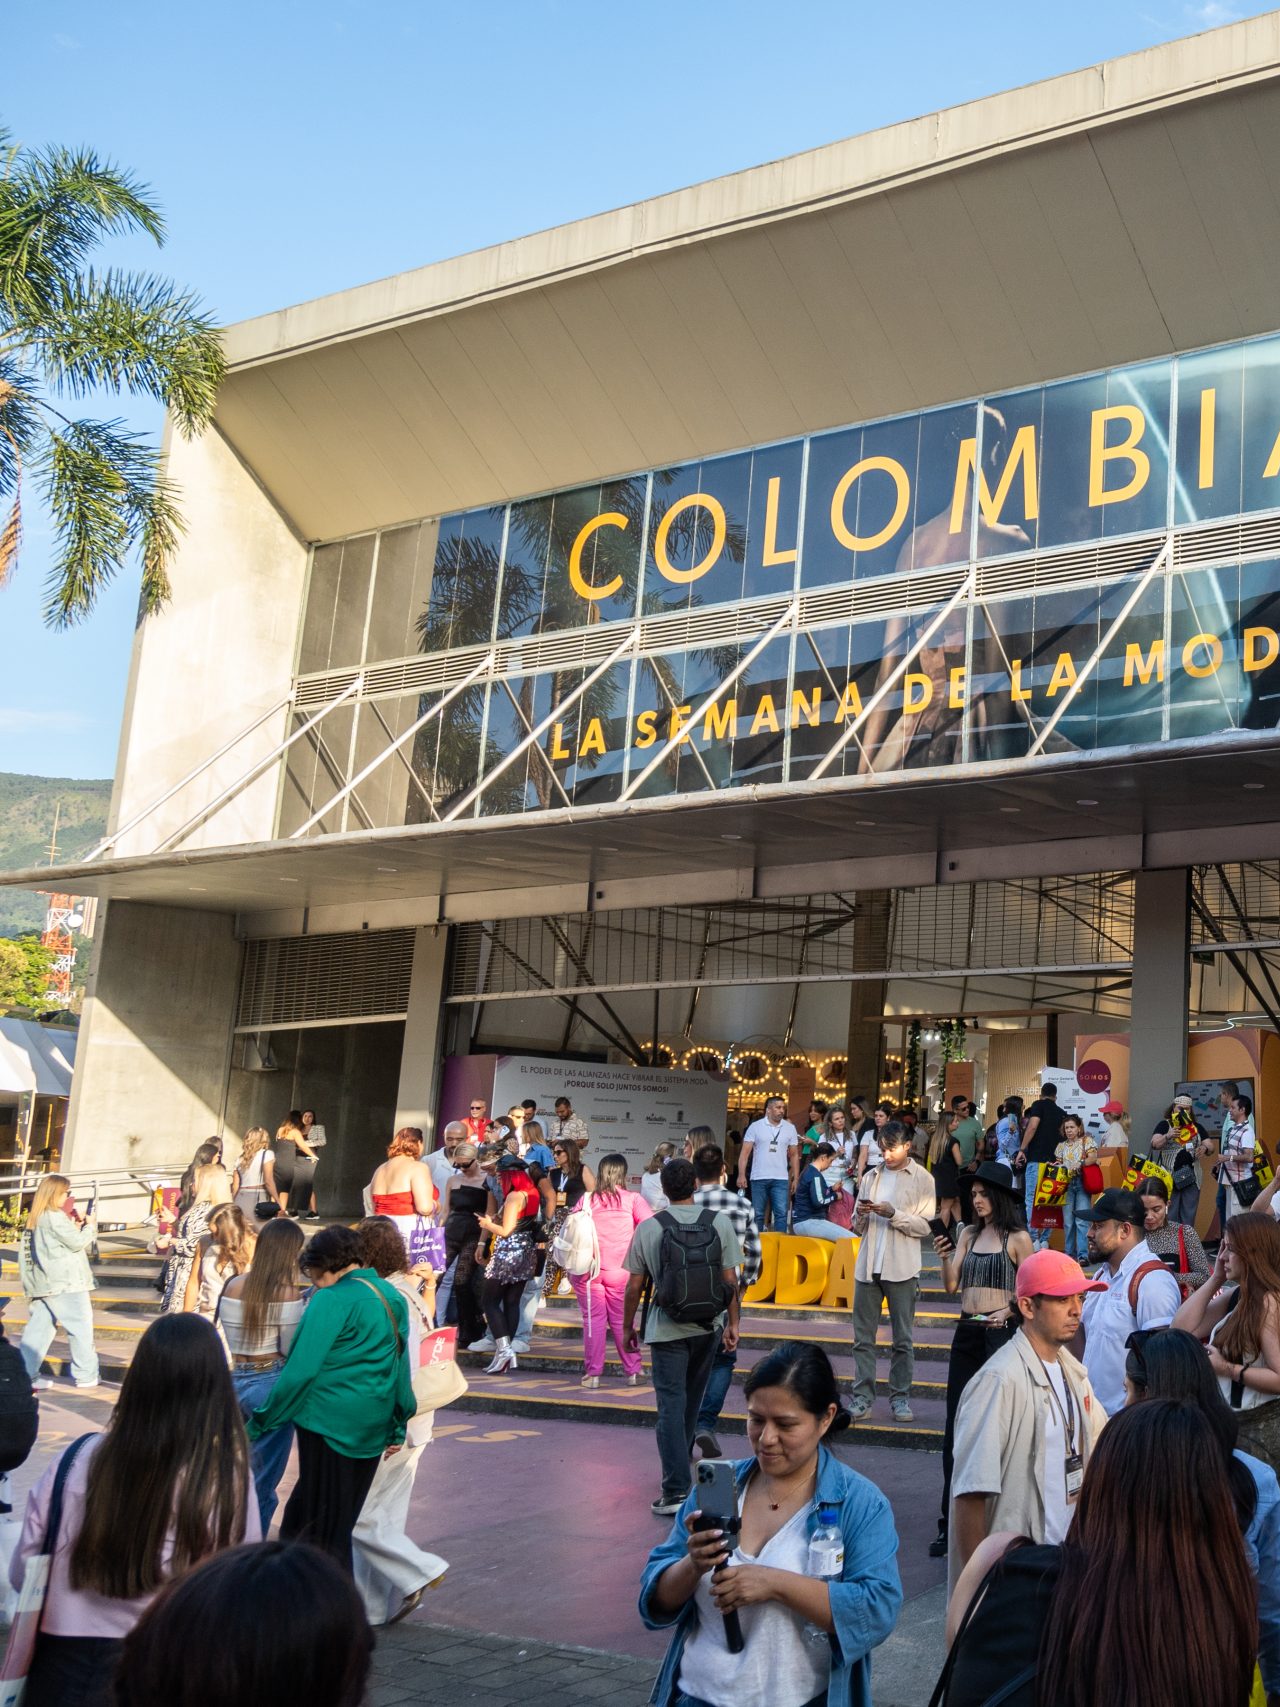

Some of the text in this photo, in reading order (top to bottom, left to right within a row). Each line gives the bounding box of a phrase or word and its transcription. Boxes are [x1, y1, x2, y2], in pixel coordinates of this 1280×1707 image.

[552, 717, 607, 760] LA
[634, 681, 865, 749] SEMANA
[902, 666, 968, 716] DE
[1011, 652, 1083, 701] LA
[520, 1066, 709, 1086] EL PODER DE LAS ALIANZAS HACE VIBRAR EL SISTEMA MODA
[564, 1080, 669, 1093] ¡PORQUE SOLO JUNTOS SOMOS!
